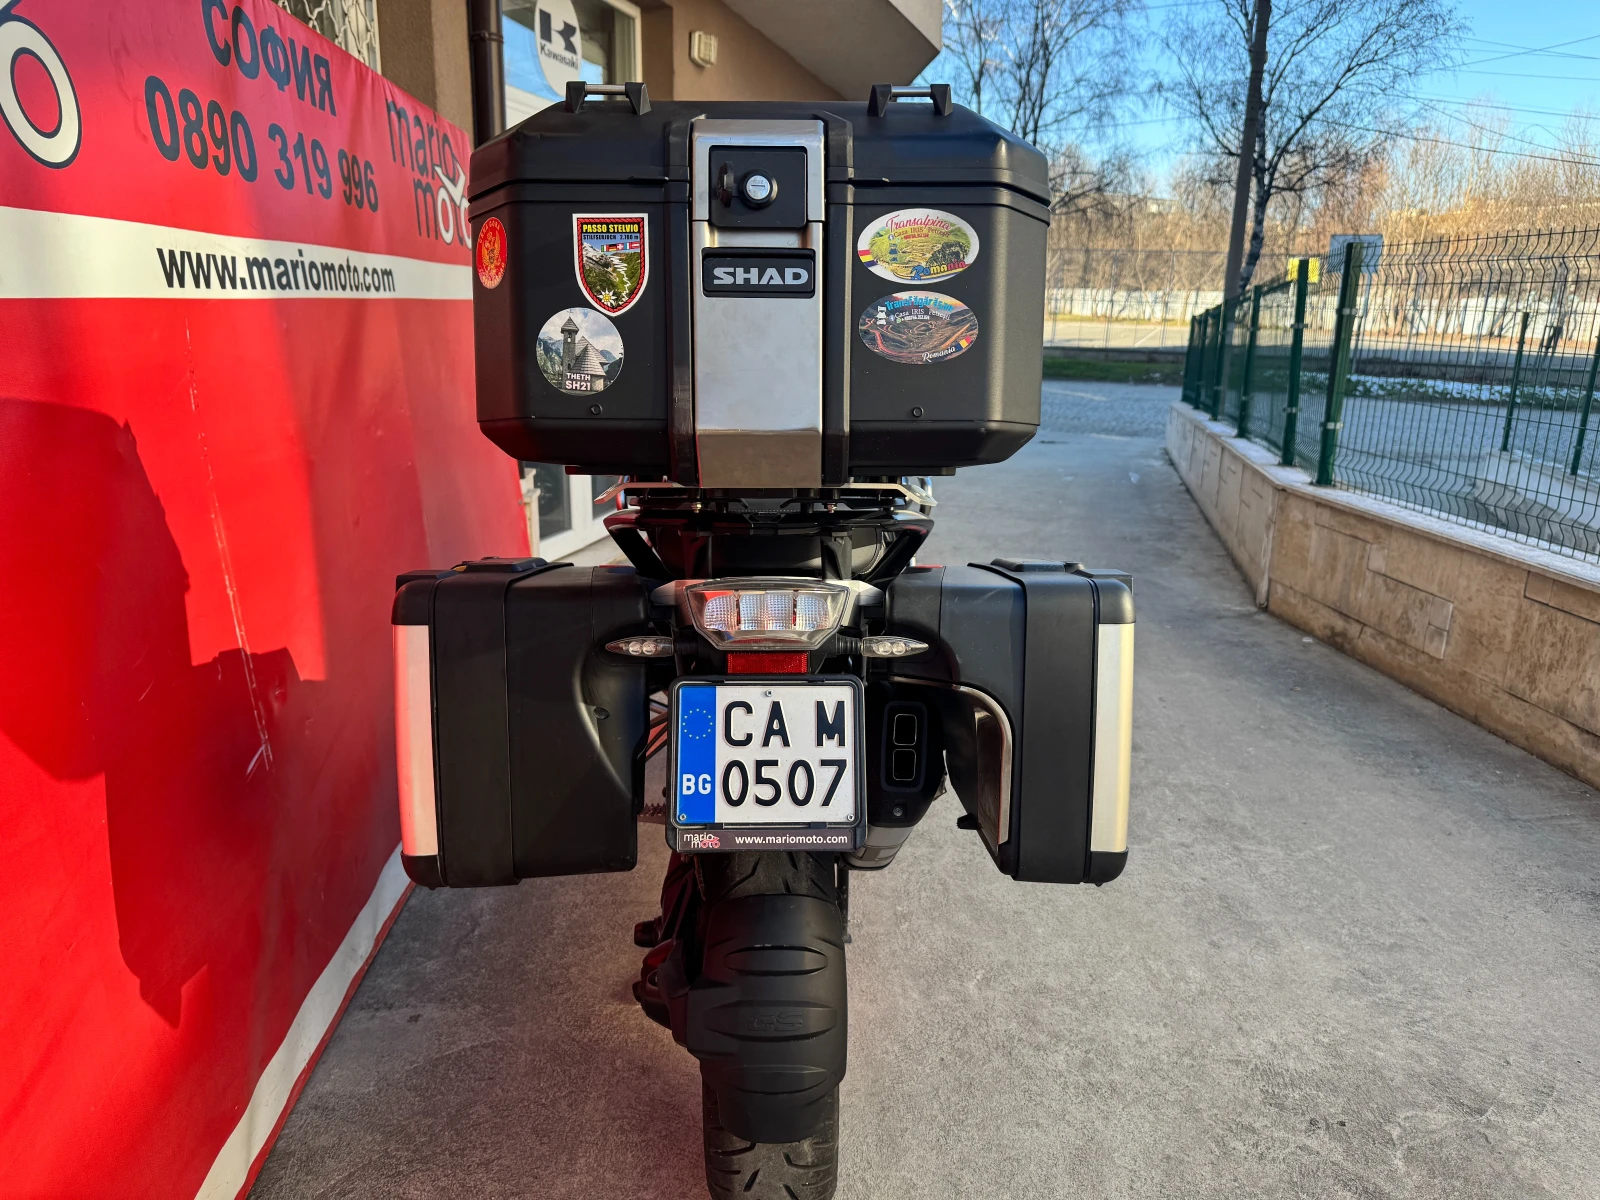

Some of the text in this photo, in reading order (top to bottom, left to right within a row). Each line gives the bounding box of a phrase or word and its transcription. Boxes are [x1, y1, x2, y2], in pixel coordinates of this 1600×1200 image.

[203, 0, 337, 117] СОФИЯ
[540, 42, 578, 70] Kawasaki
[144, 75, 258, 183] 0890
[268, 123, 333, 200] 319
[337, 148, 379, 213] 996
[385, 97, 457, 184] mario
[582, 224, 639, 233] PASSO STELVIO
[886, 214, 951, 233] Transalpina
[910, 226, 924, 234] IRIS
[156, 247, 396, 293] www.mariomoto.com
[713, 267, 809, 285] SHAD
[911, 308, 925, 316] IRIS
[565, 380, 591, 391] SH21
[566, 372, 591, 381] THETH
[724, 700, 846, 748] CA M
[682, 774, 712, 796] BG
[722, 759, 848, 807] 0507
[683, 832, 715, 843] mario
[691, 839, 721, 849] moto
[735, 834, 848, 845] www.mariomoto.com
